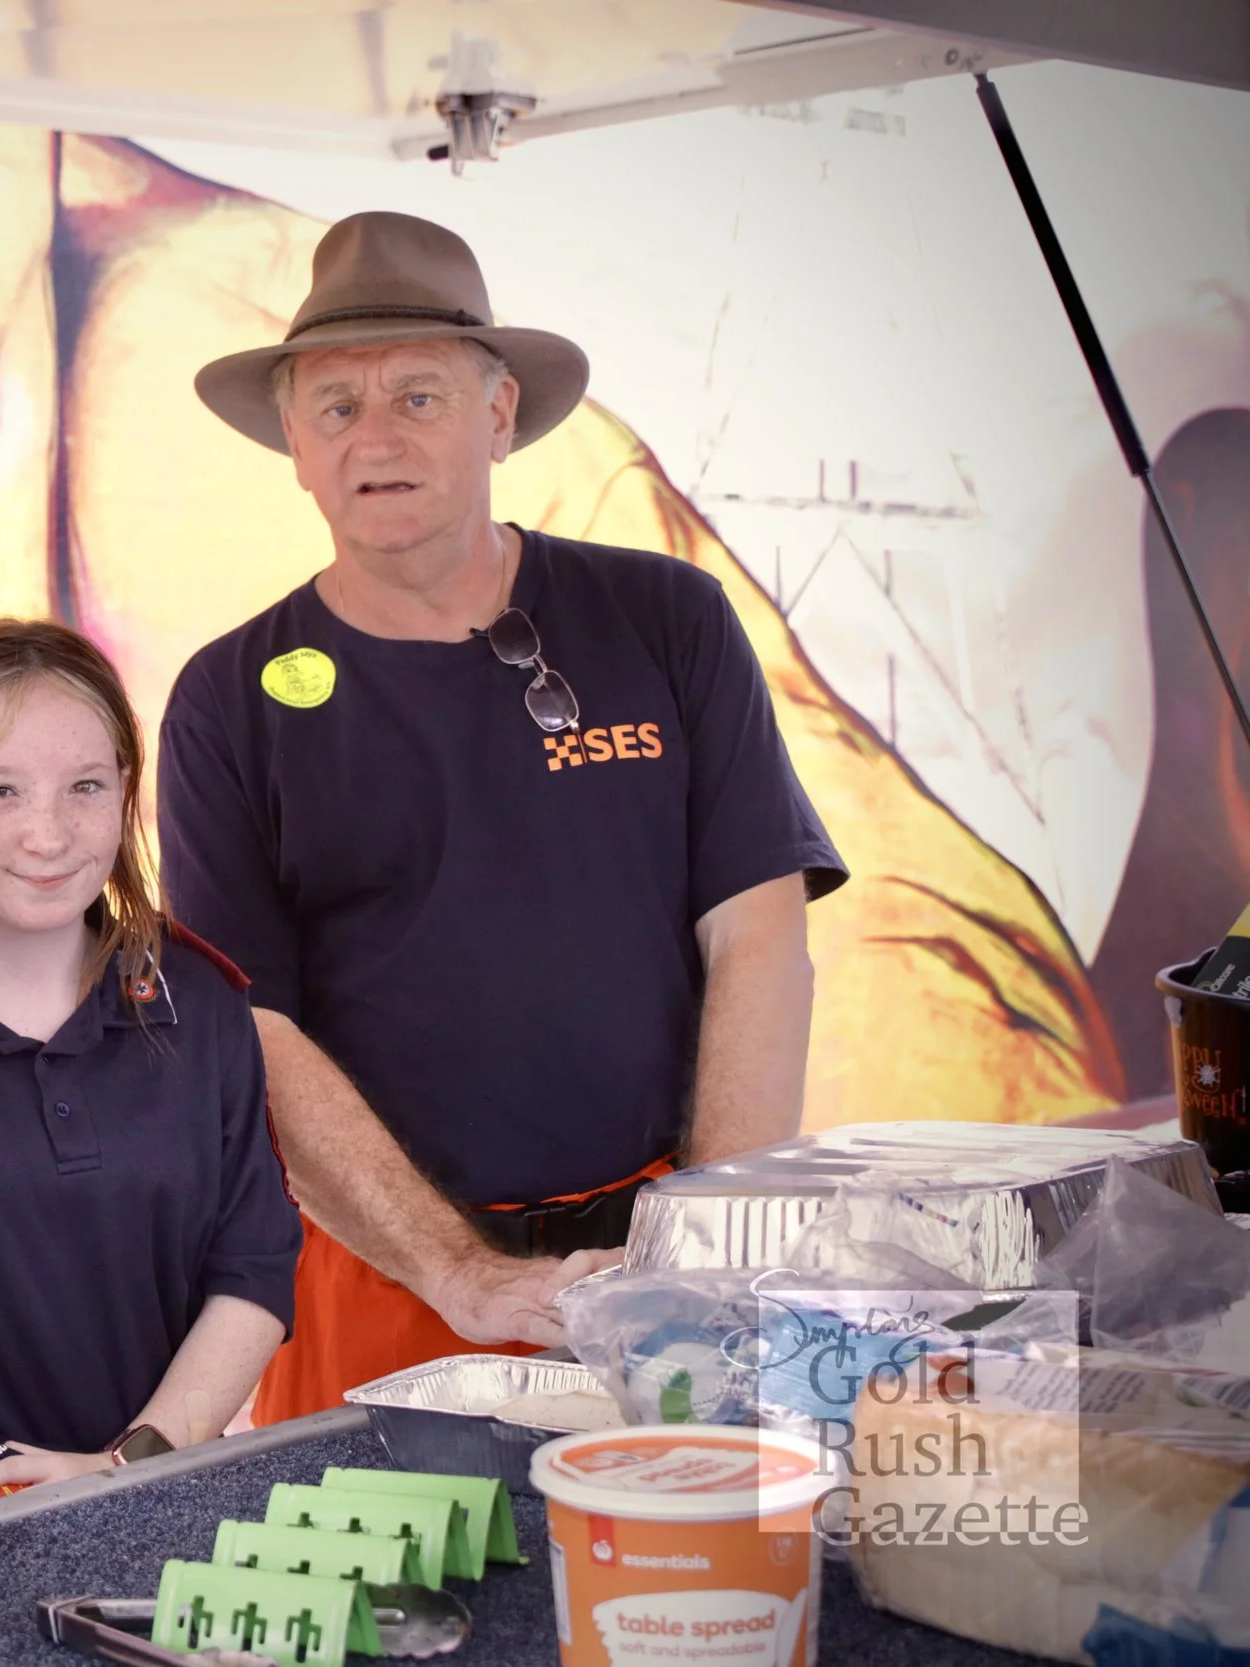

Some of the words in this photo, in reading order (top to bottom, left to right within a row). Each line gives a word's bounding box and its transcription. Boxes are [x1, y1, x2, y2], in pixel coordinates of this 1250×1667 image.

[583, 722, 662, 762] SES
[622, 1554, 711, 1570] essentials
[617, 1611, 684, 1636] table
[691, 1608, 775, 1642] spread
[619, 1641, 646, 1655] soft
[651, 1644, 680, 1657] and
[684, 1641, 766, 1661] spreadable
